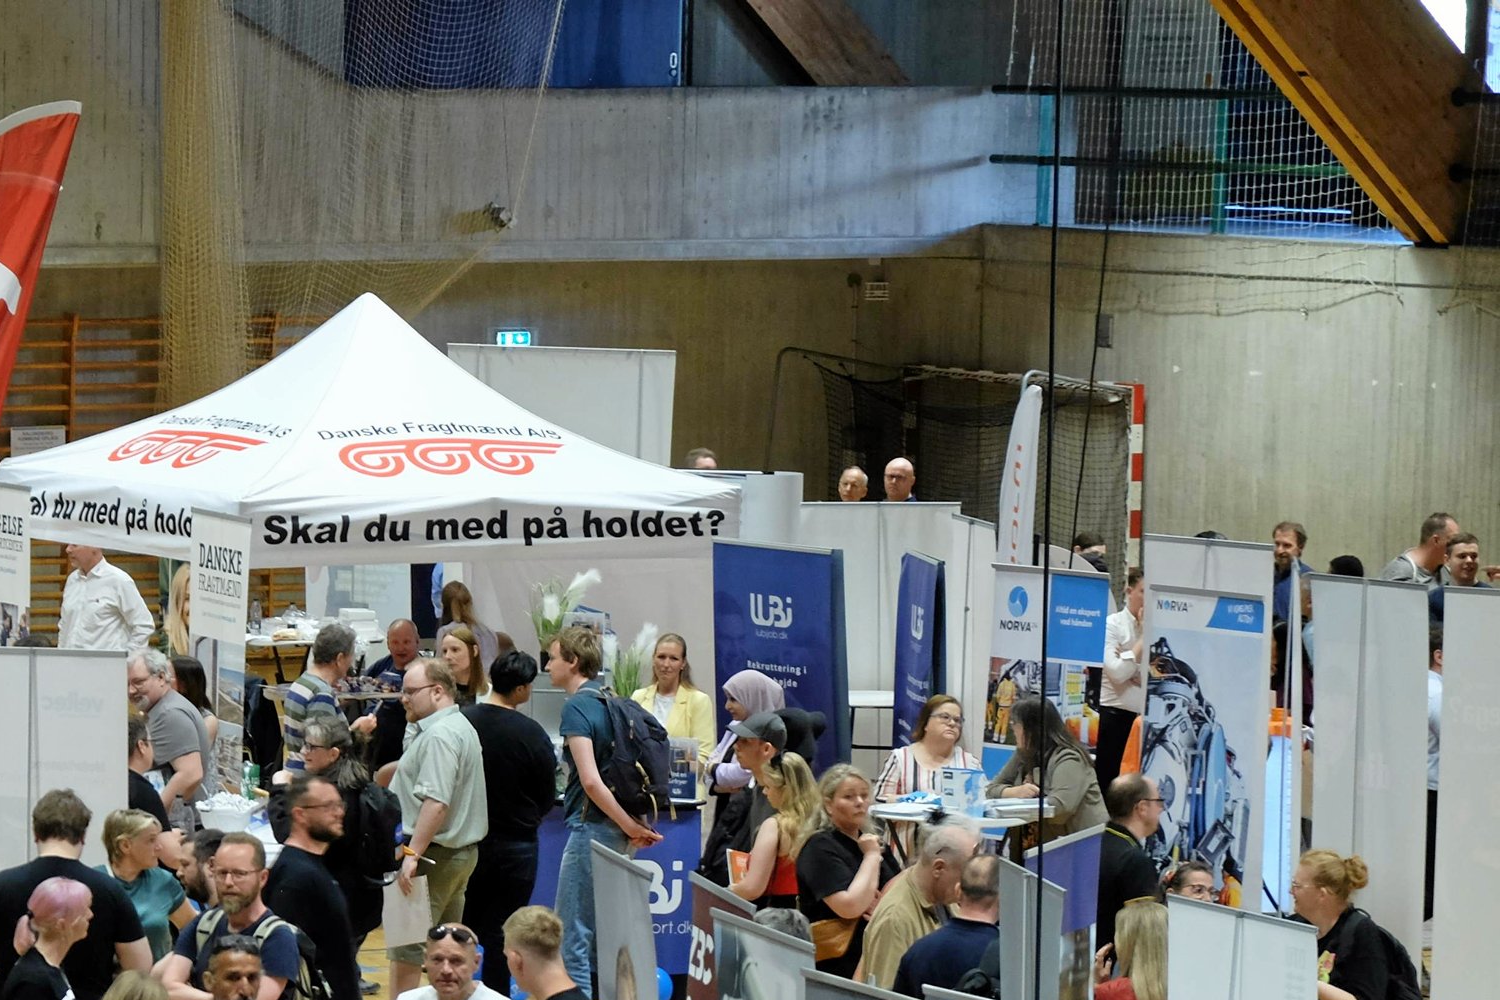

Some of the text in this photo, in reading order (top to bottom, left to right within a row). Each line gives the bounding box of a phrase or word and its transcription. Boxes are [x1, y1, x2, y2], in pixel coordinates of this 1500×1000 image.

[317, 421, 562, 440] Danske Fragtmænd A/S
[30, 491, 47, 516] al
[52, 492, 75, 520] du
[79, 497, 120, 528] med
[125, 499, 148, 536] på
[263, 507, 726, 545] Skal du med på holdet?
[199, 543, 242, 575] DANSKE
[1000, 620, 1031, 632] NORVA
[747, 660, 807, 676] Rekruttering i
[653, 921, 695, 934] ort.dk
